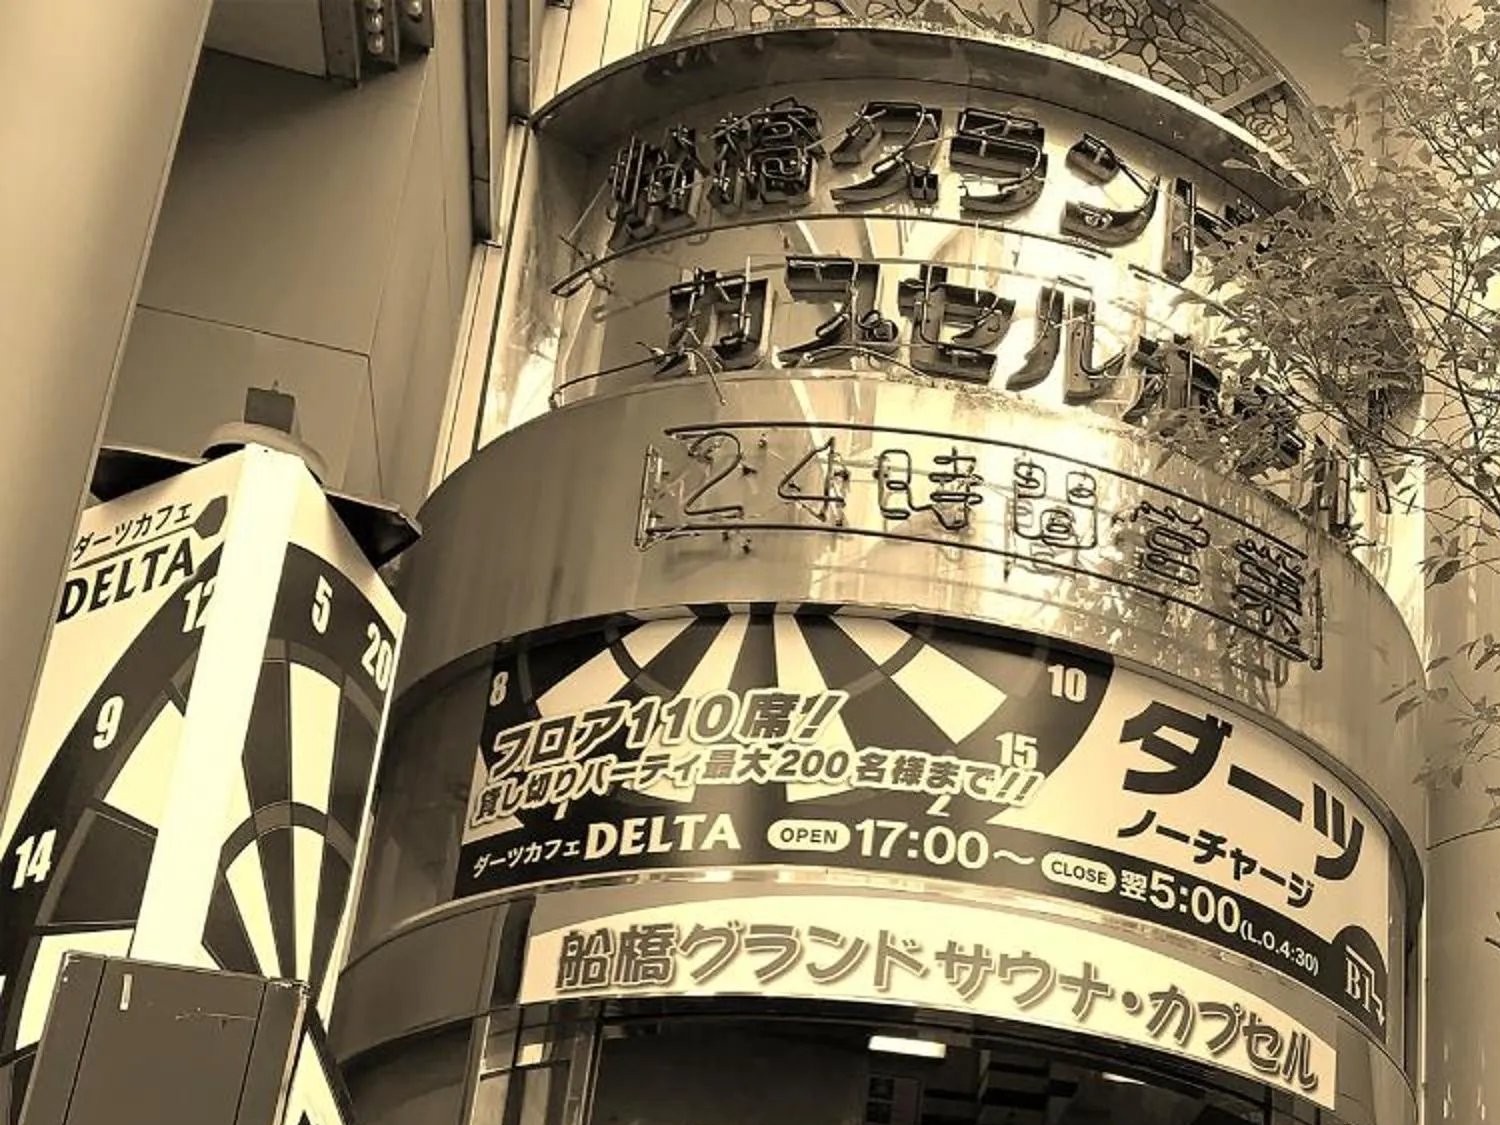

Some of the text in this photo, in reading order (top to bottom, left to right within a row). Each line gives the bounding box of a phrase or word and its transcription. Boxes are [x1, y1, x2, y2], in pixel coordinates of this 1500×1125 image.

[73, 502, 193, 563] ダーツカフェ
[56, 536, 195, 624] DELTA
[311, 575, 334, 634] 5
[361, 622, 395, 692] 20
[1048, 664, 1088, 703] 10
[489, 671, 509, 707] 8
[92, 694, 125, 750] 9
[995, 732, 1040, 770] 15
[1118, 699, 1366, 882] ダーツ
[12, 828, 57, 890] 14
[473, 838, 581, 878] ダーツカフェ
[584, 813, 742, 861] DELTA
[780, 826, 838, 845] OPEN
[1050, 860, 1109, 888] CLOSE
[1119, 868, 1241, 936] 翌5:00
[1117, 808, 1316, 910] ノーチャージ
[554, 918, 1321, 1096] 船橋グランドサウナ・カプセル
